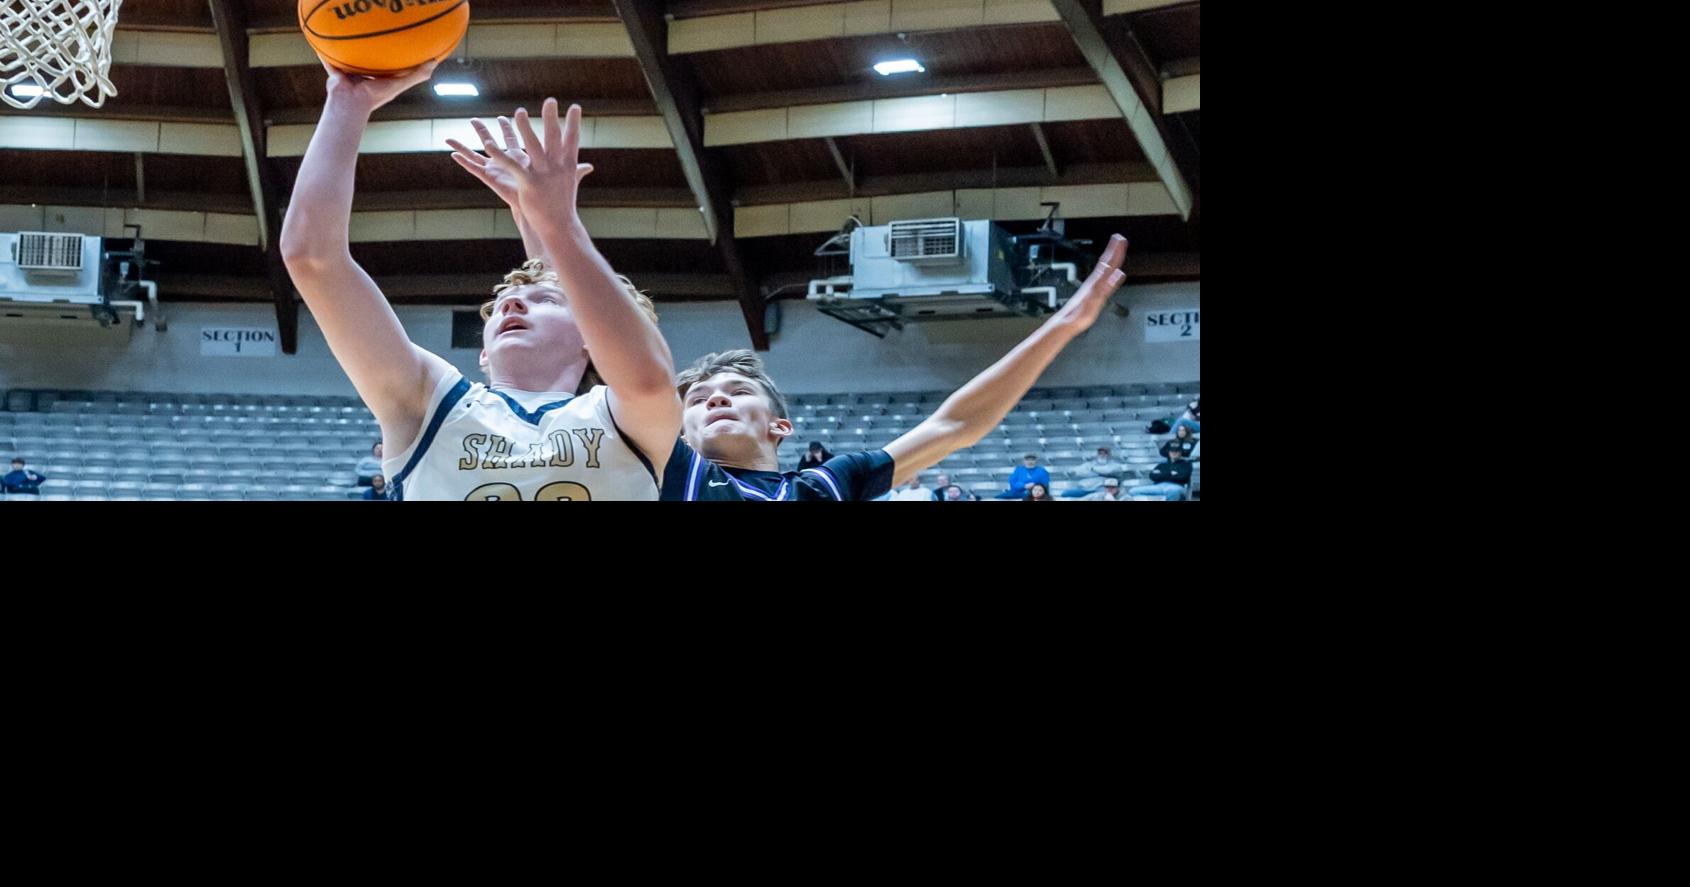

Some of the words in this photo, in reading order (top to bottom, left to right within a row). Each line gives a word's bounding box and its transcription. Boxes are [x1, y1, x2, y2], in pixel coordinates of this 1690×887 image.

[1181, 325, 1192, 336] 2
[202, 331, 274, 342] SECTION
[234, 342, 240, 352] 1
[458, 428, 605, 470] SHADY
